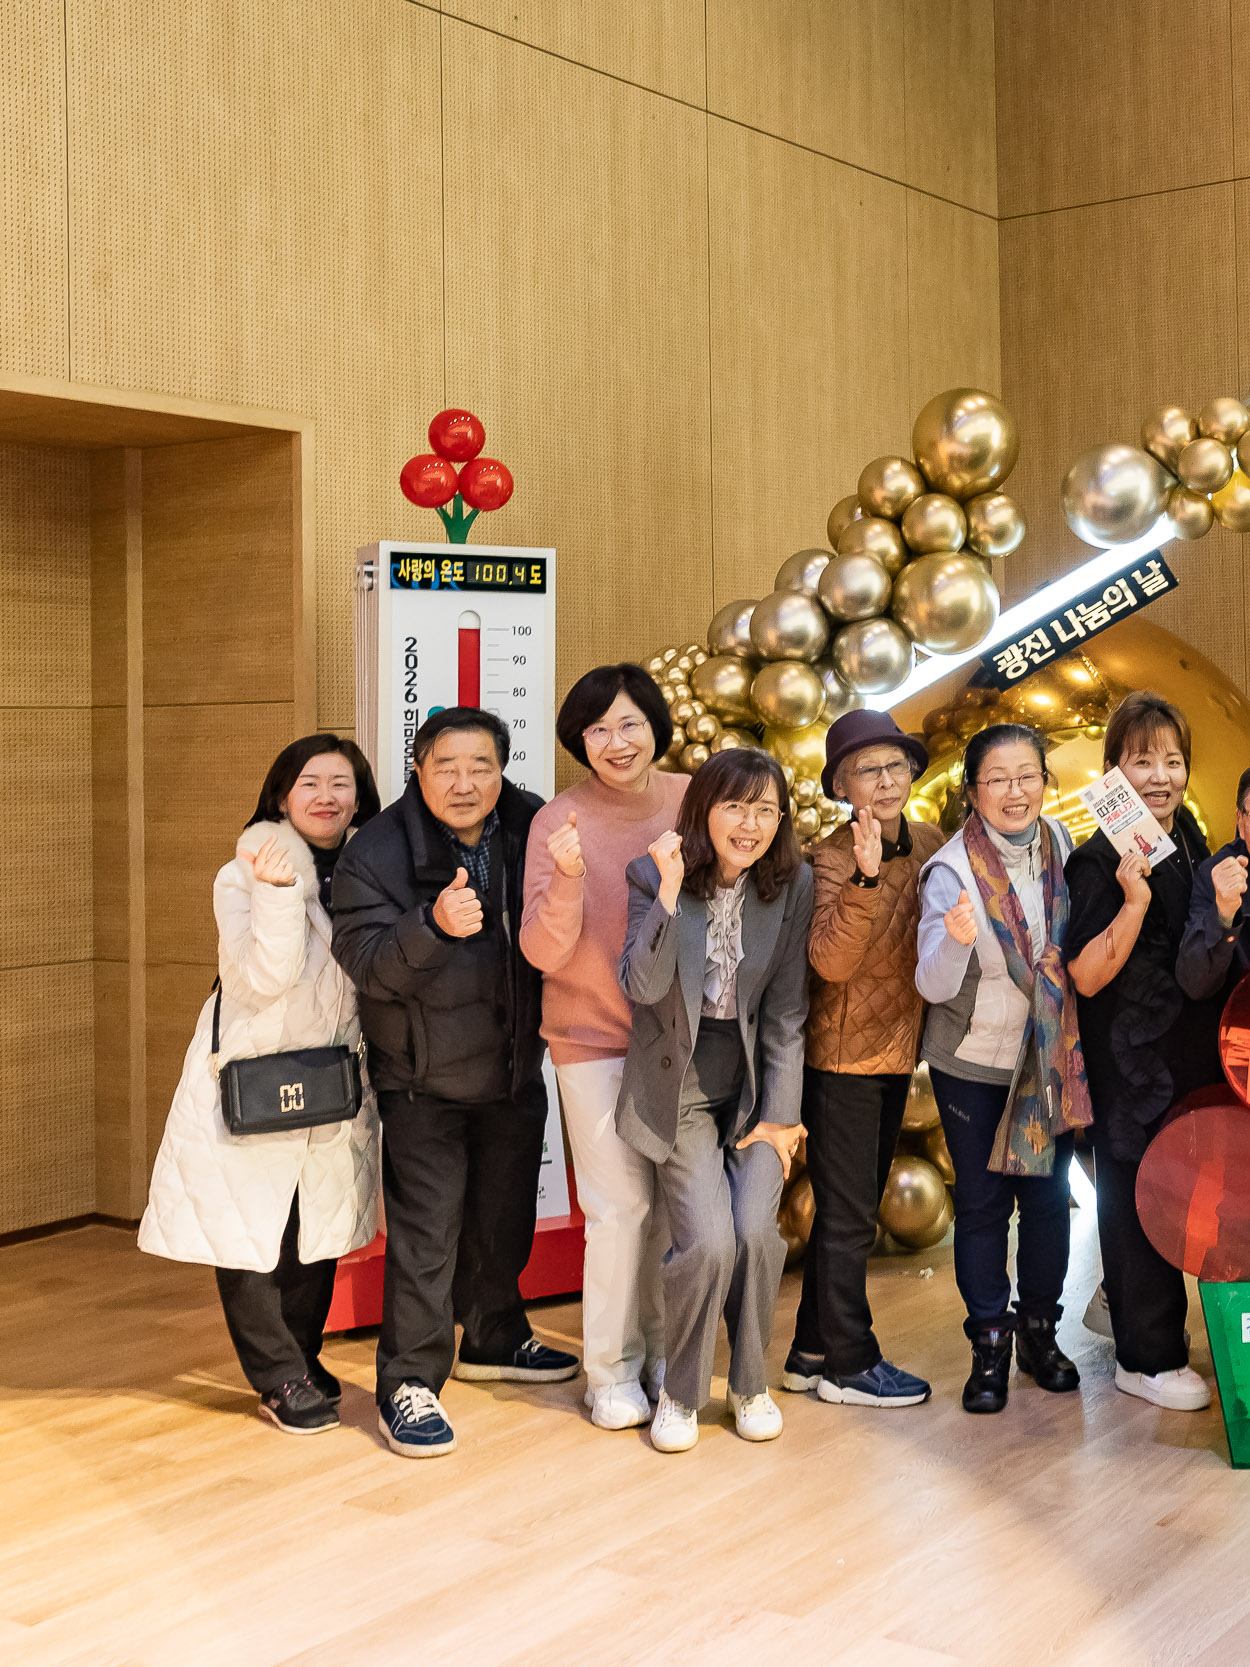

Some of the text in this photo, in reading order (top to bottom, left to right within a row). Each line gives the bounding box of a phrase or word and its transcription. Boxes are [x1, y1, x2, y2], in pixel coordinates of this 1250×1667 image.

[398, 558, 435, 582] 사랑의
[440, 559, 465, 582] 온도
[529, 564, 542, 585] 도
[992, 559, 1169, 679] 광진 나눔의 날
[511, 625, 532, 636] 100
[512, 655, 527, 666] 90
[404, 636, 418, 703] 2026
[512, 687, 527, 697] 80
[512, 719, 526, 729] 70
[512, 750, 526, 761] 60
[1096, 790, 1131, 818] 따뜻한
